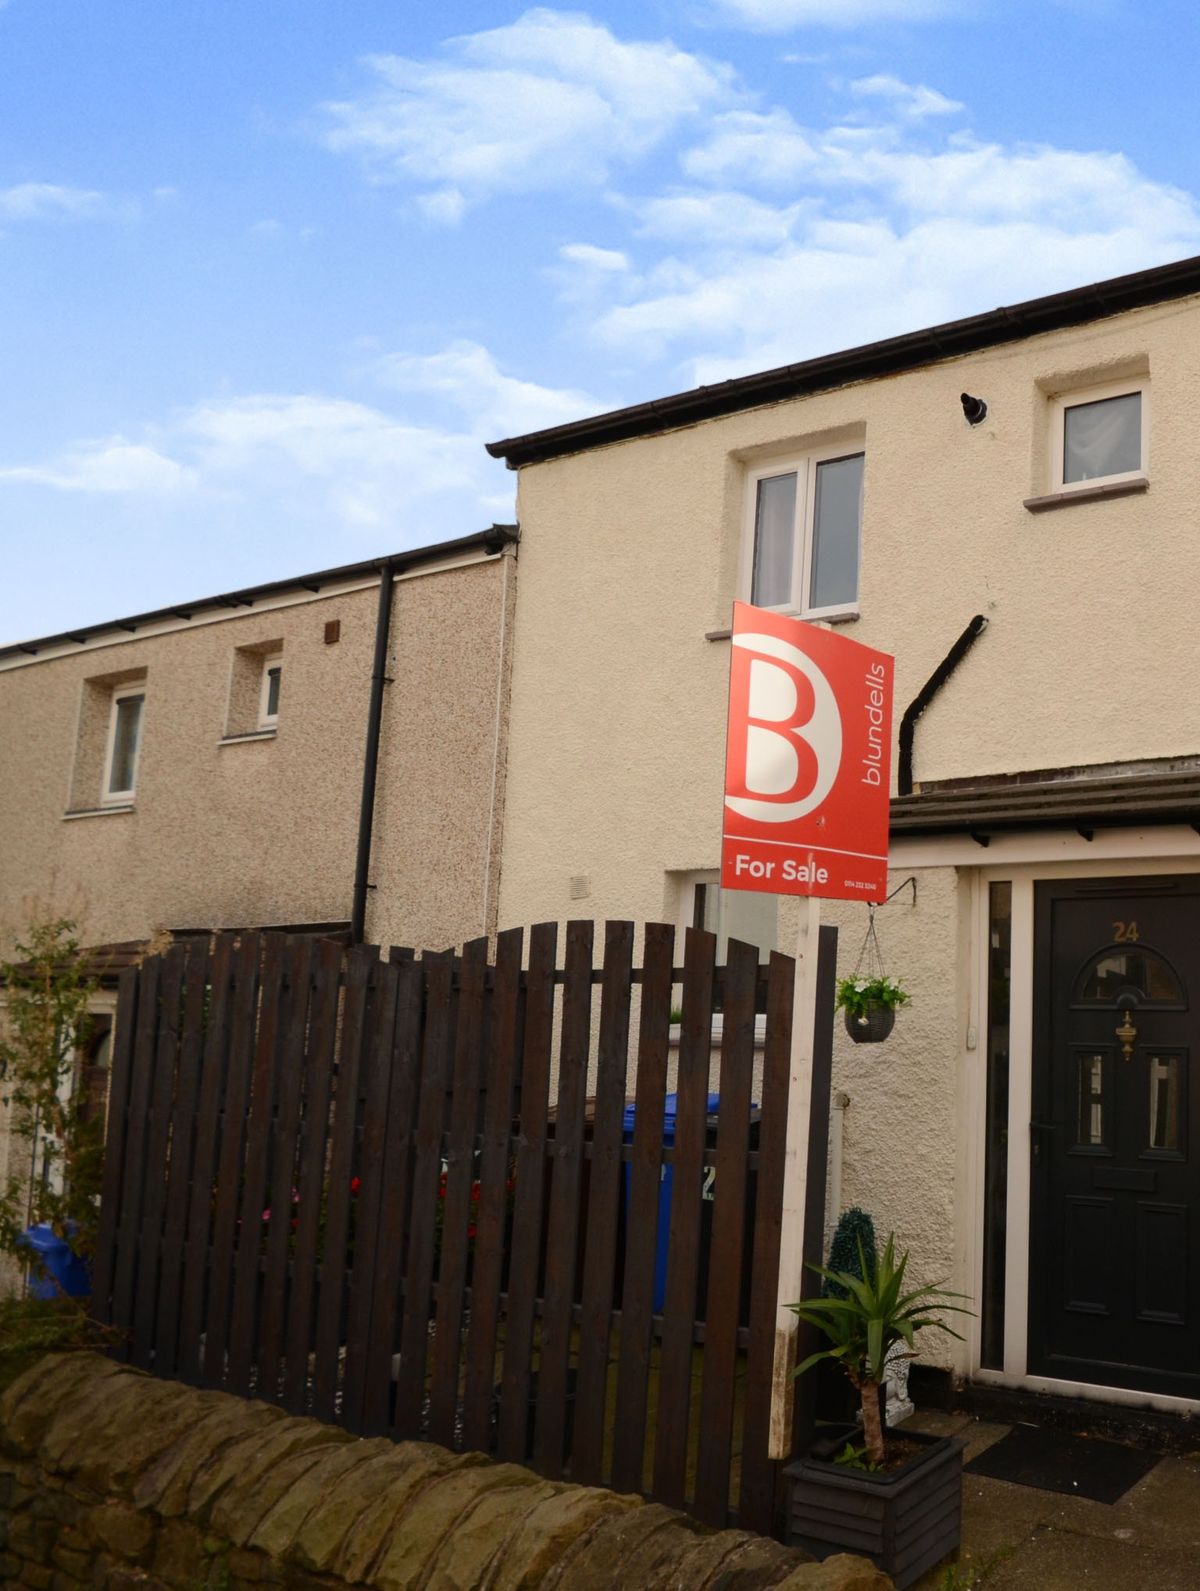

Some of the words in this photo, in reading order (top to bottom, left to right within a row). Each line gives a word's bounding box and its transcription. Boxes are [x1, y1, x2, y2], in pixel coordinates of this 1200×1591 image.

[727, 643, 820, 805] B
[862, 663, 885, 786] blundells
[735, 854, 776, 879] For
[782, 859, 829, 884] Sale
[1112, 921, 1139, 942] 24
